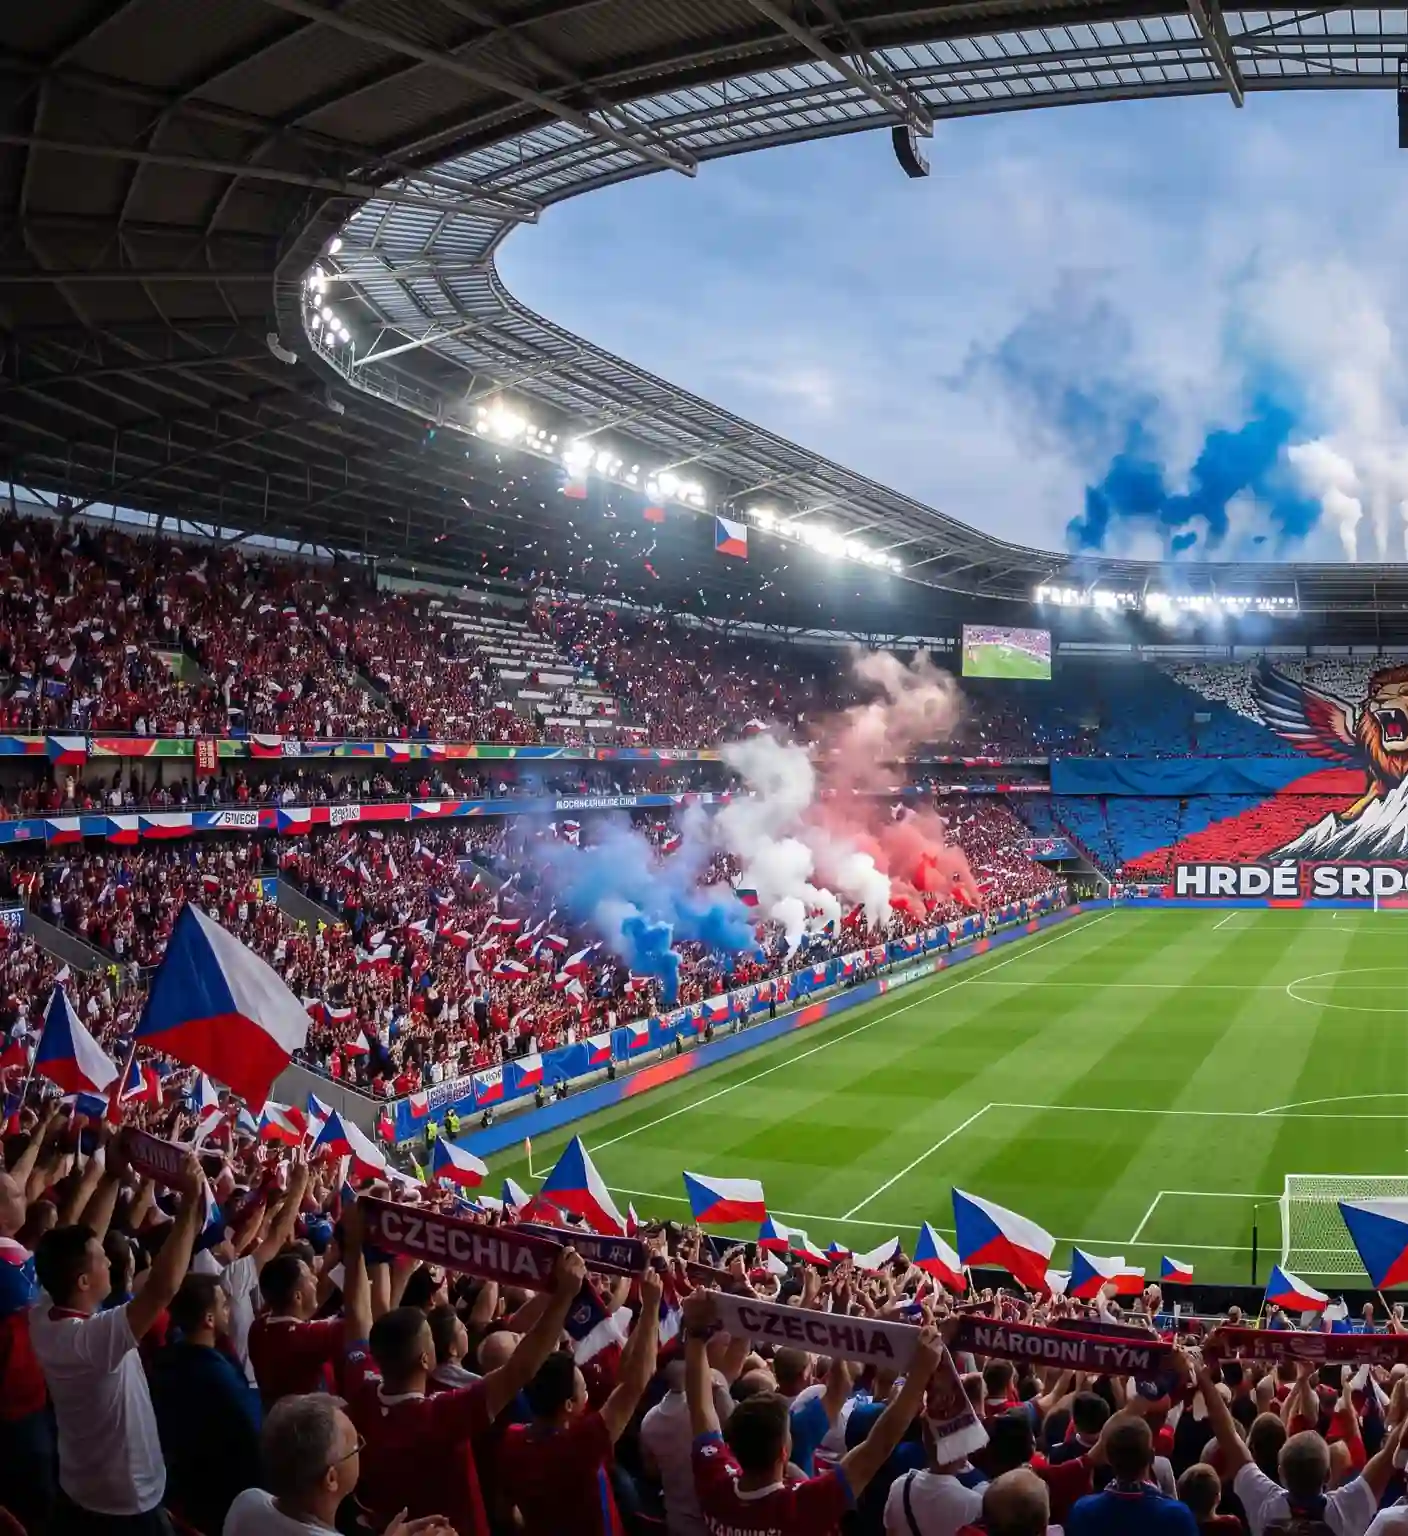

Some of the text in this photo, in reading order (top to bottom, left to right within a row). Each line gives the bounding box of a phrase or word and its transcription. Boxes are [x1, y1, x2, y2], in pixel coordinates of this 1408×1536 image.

[1177, 859, 1298, 895] HRDÉ
[380, 1210, 540, 1281] CZECHIA
[737, 1305, 895, 1359] CZECHIA
[974, 1326, 1149, 1369] NÁRODNÍ TÝM
